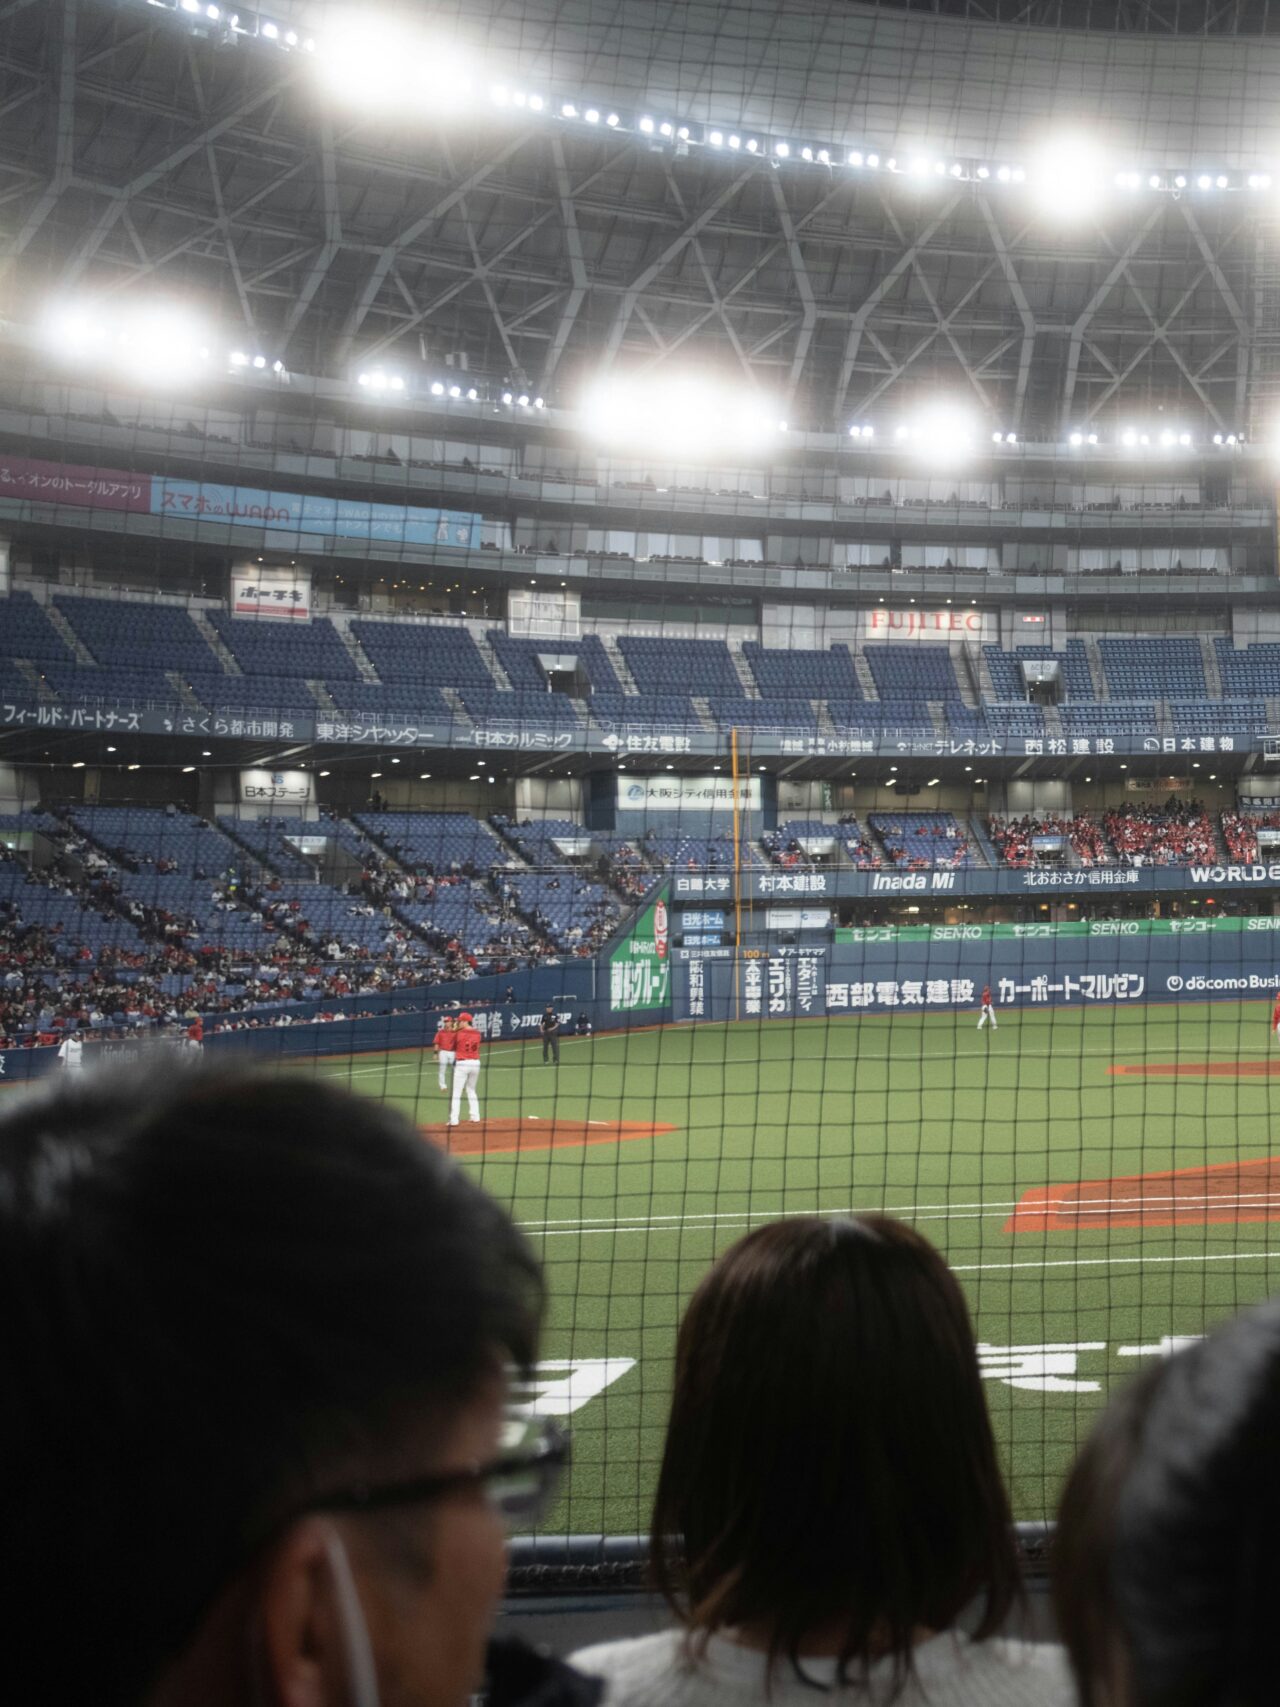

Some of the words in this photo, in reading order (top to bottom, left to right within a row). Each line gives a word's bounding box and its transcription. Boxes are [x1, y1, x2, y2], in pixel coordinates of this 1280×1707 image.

[160, 490, 290, 523] スマホのWAON
[240, 586, 303, 602] ホーチキ
[872, 611, 983, 636] FUJITEC
[182, 716, 294, 738] さくら都市開発
[475, 731, 572, 748] 日本カルミック
[935, 739, 1002, 755] テレネット
[1025, 738, 1115, 755] 西松建設
[1162, 737, 1234, 752] 日本建物
[245, 786, 311, 799] 日本ステージ
[873, 872, 926, 890] Inada
[1023, 869, 1139, 886] 北おおさか信用金庫
[1191, 865, 1265, 883] WORLD
[759, 875, 826, 891] 村本建設
[682, 912, 723, 926] 日光ホーム
[1169, 919, 1216, 932] センコー
[853, 929, 900, 942] センコー
[933, 926, 982, 940] SENKO
[1012, 924, 1060, 938] センコー
[1091, 921, 1139, 935] SENKO
[743, 950, 760, 958] 100
[768, 958, 785, 1013] エコリカ
[797, 958, 813, 1012] エタニティ
[998, 974, 1145, 1003] カーポートマルゼン
[1185, 974, 1249, 990] docomo
[825, 980, 975, 1007] 西部電気建設
